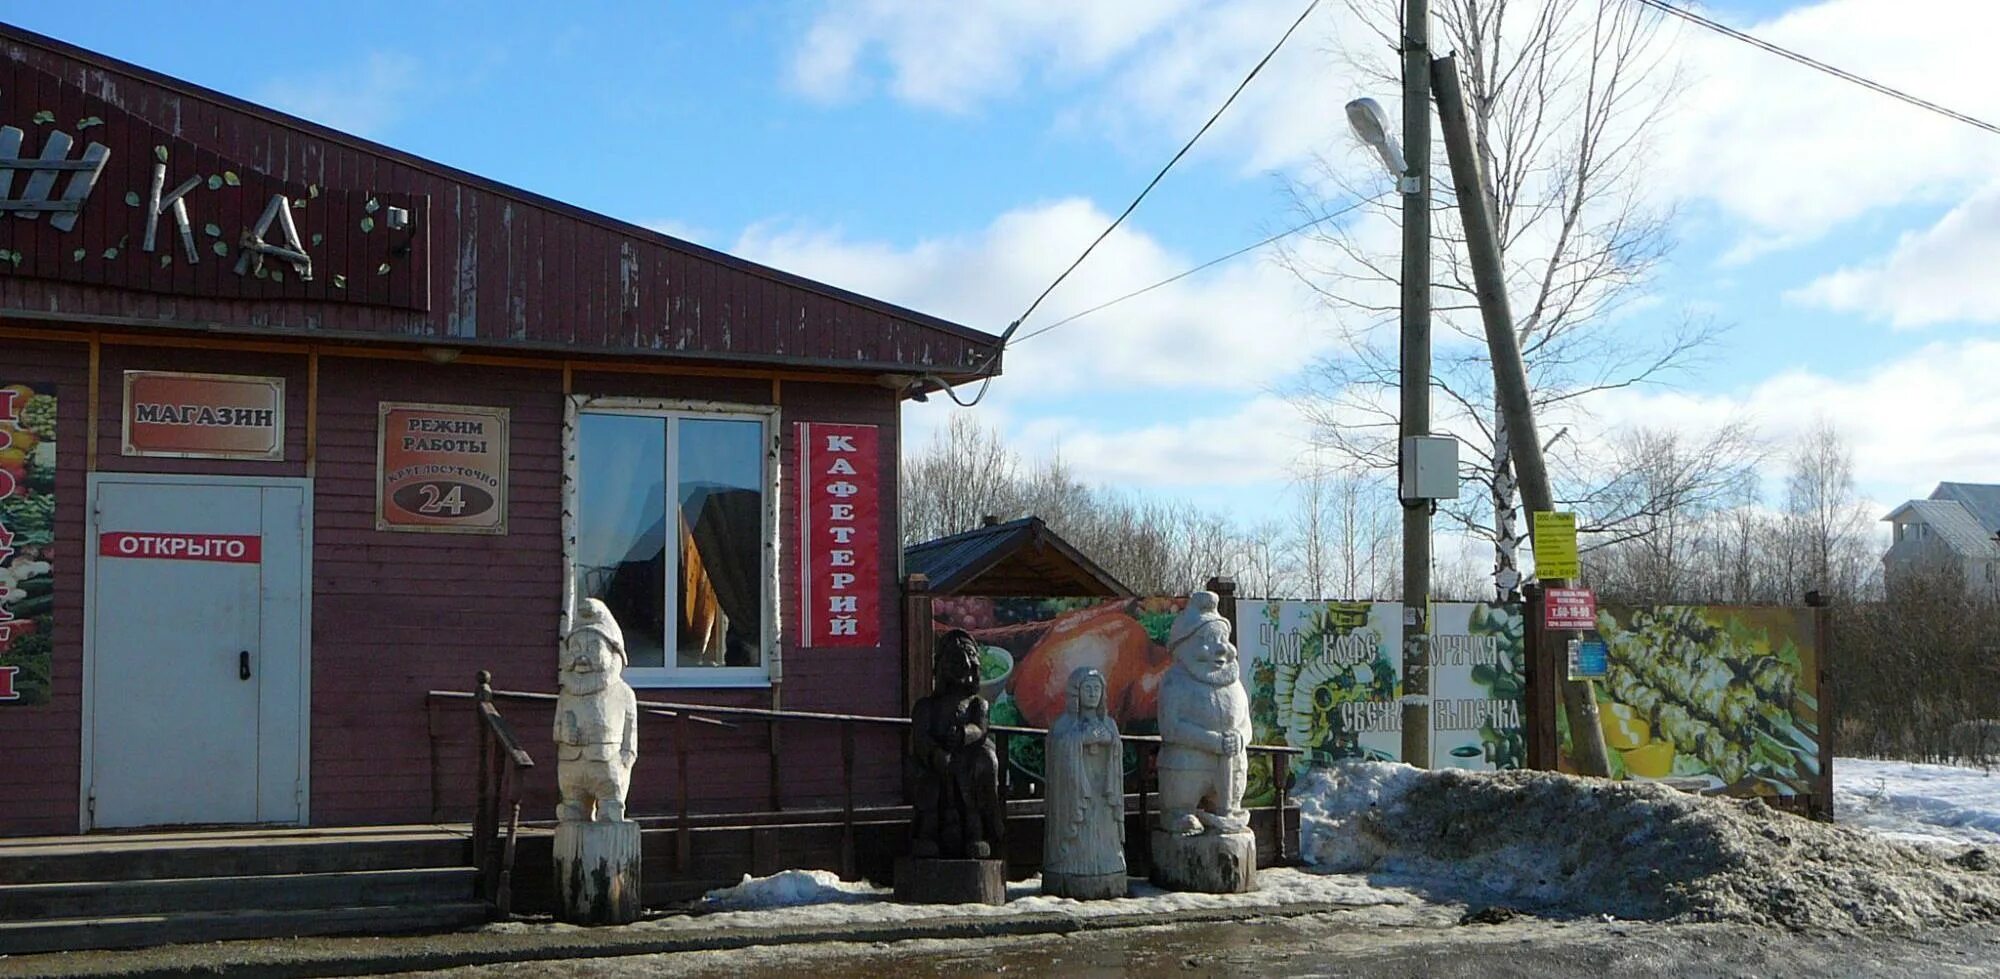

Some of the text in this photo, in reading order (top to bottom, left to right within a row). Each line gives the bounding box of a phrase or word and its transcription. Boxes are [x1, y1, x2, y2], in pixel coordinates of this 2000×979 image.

[135, 403, 275, 428] МАГАЗИН
[408, 418, 484, 435] РЕЖИМ
[403, 437, 488, 454] РАБОТЫ
[387, 464, 499, 488] КРУГЛОСУТОЧНО
[419, 484, 466, 515] 24
[118, 537, 246, 559] ОТКРЫТО
[826, 435, 859, 637] КАФЕТЕРИЙ
[1429, 634, 1498, 666] орячая
